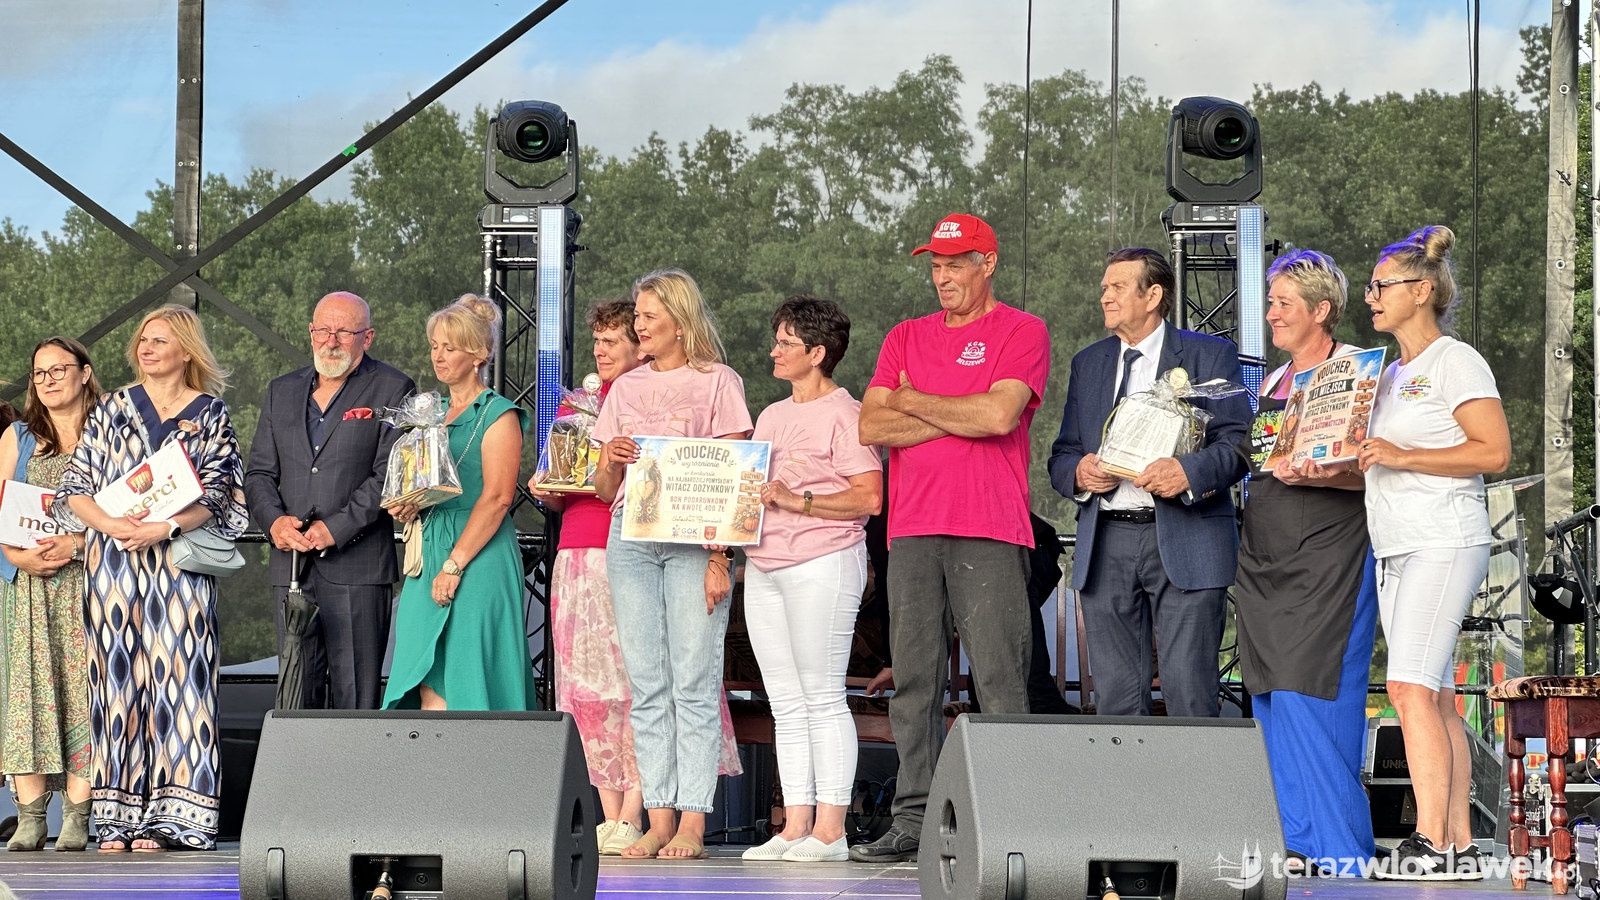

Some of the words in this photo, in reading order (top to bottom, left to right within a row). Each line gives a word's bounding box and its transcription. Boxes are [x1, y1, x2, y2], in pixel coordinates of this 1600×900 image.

[1317, 360, 1351, 382] VOUCHER
[1319, 380, 1347, 396] MIEJSCA
[675, 445, 730, 463] VOUCHER
[665, 482, 691, 492] WITACZ
